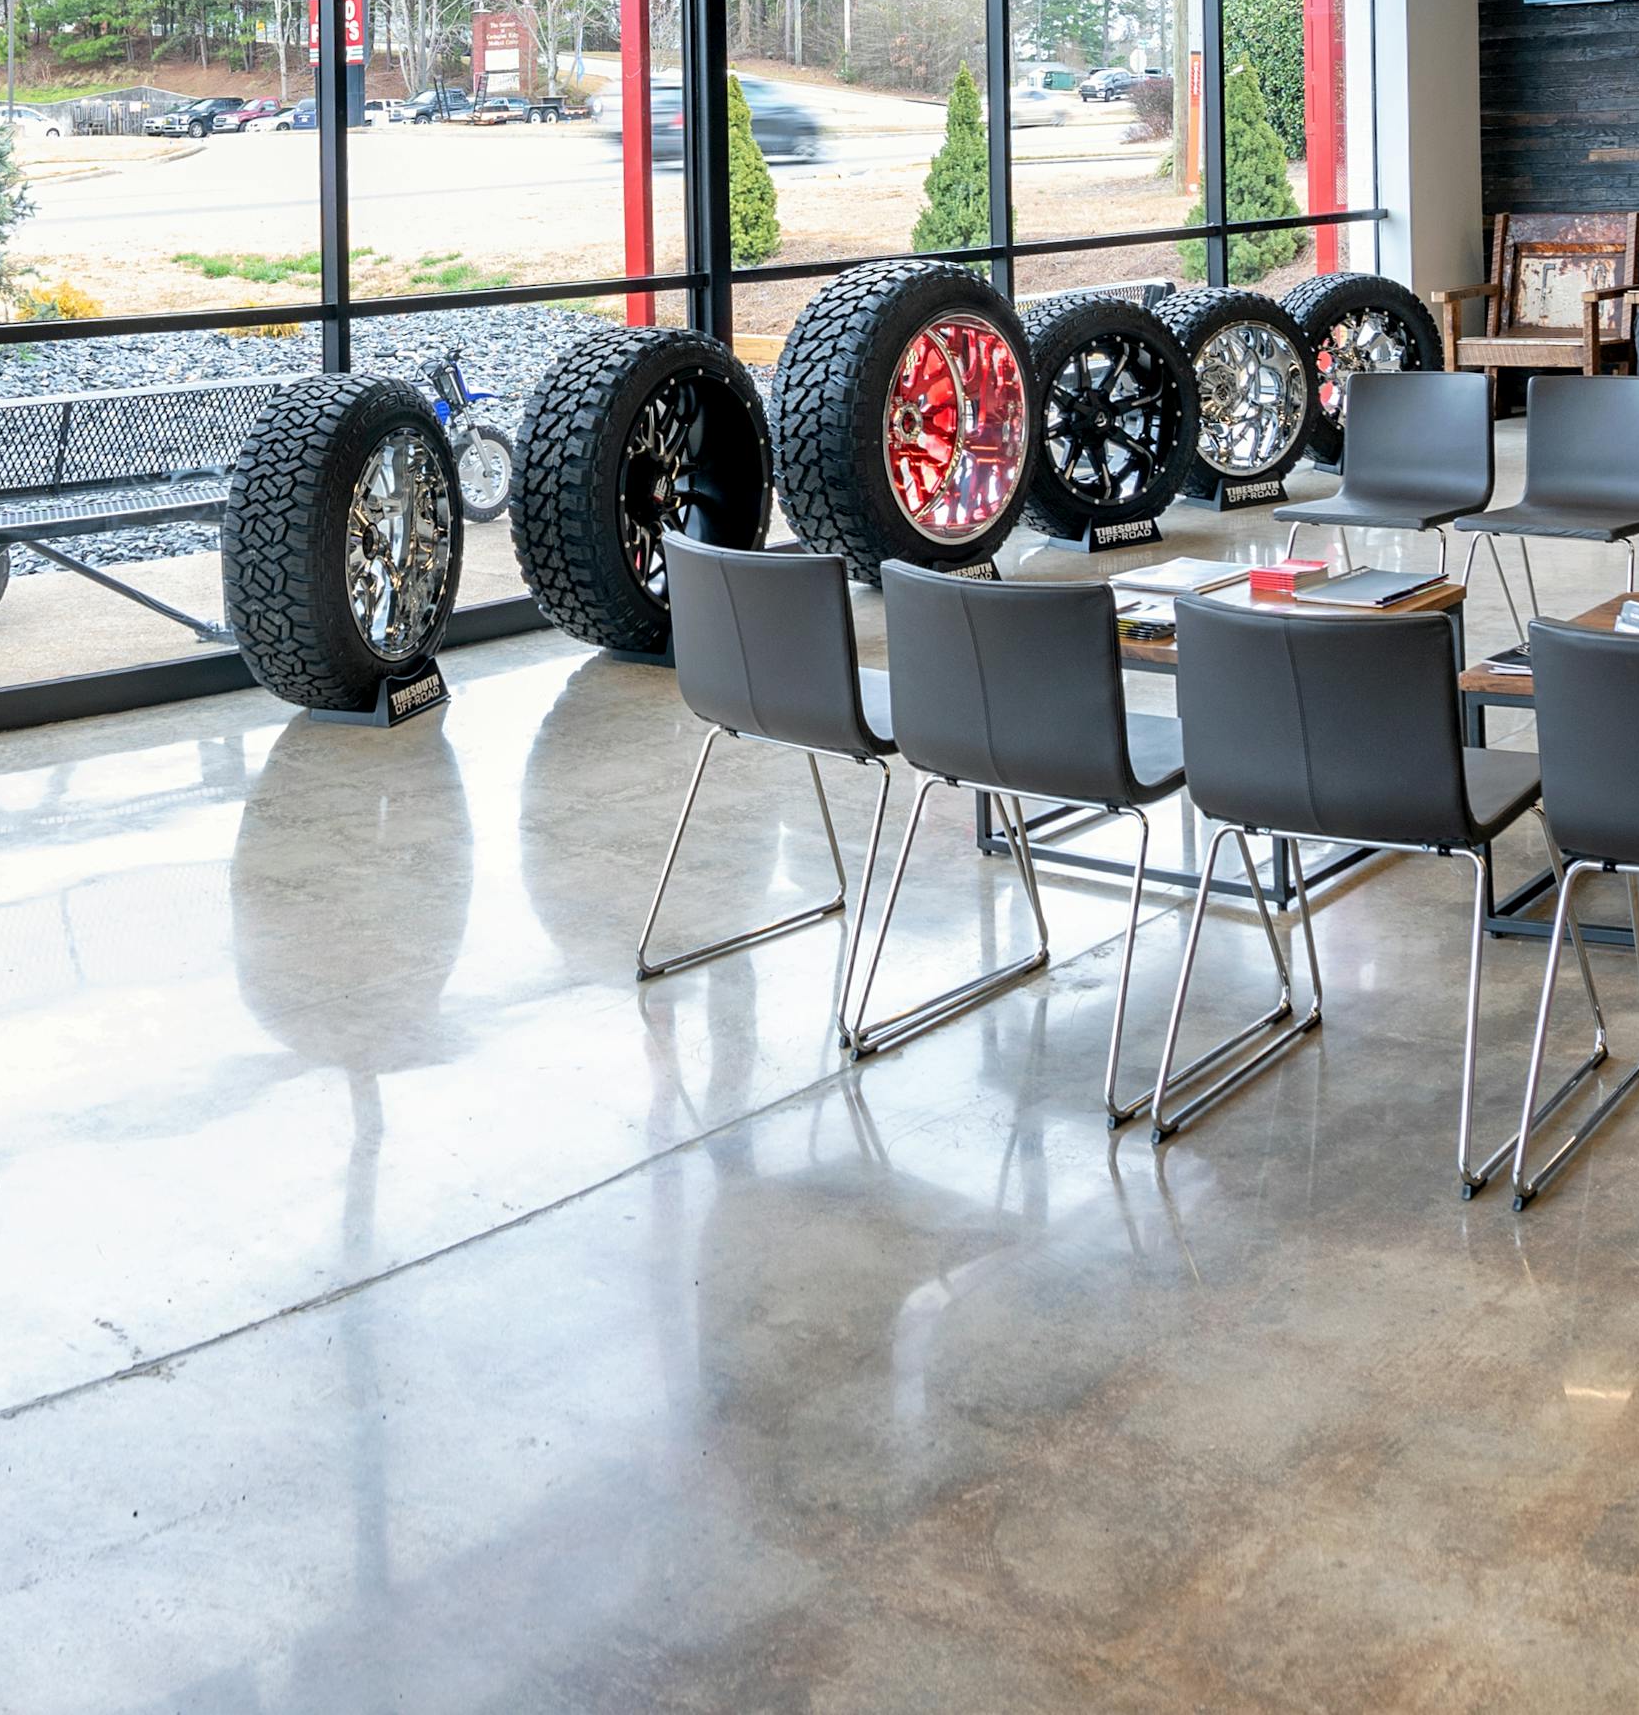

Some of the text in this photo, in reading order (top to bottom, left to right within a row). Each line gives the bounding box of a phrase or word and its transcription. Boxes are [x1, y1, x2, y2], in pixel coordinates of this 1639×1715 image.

[1225, 480, 1280, 497] TIRESOUTH
[1228, 489, 1280, 503] OFF-ROAD
[1094, 518, 1153, 538] TIRESOUTH
[1097, 528, 1152, 545] OFF-ROAD
[390, 673, 440, 706] TIRESOUTH
[395, 686, 441, 716] OFF-ROAD
